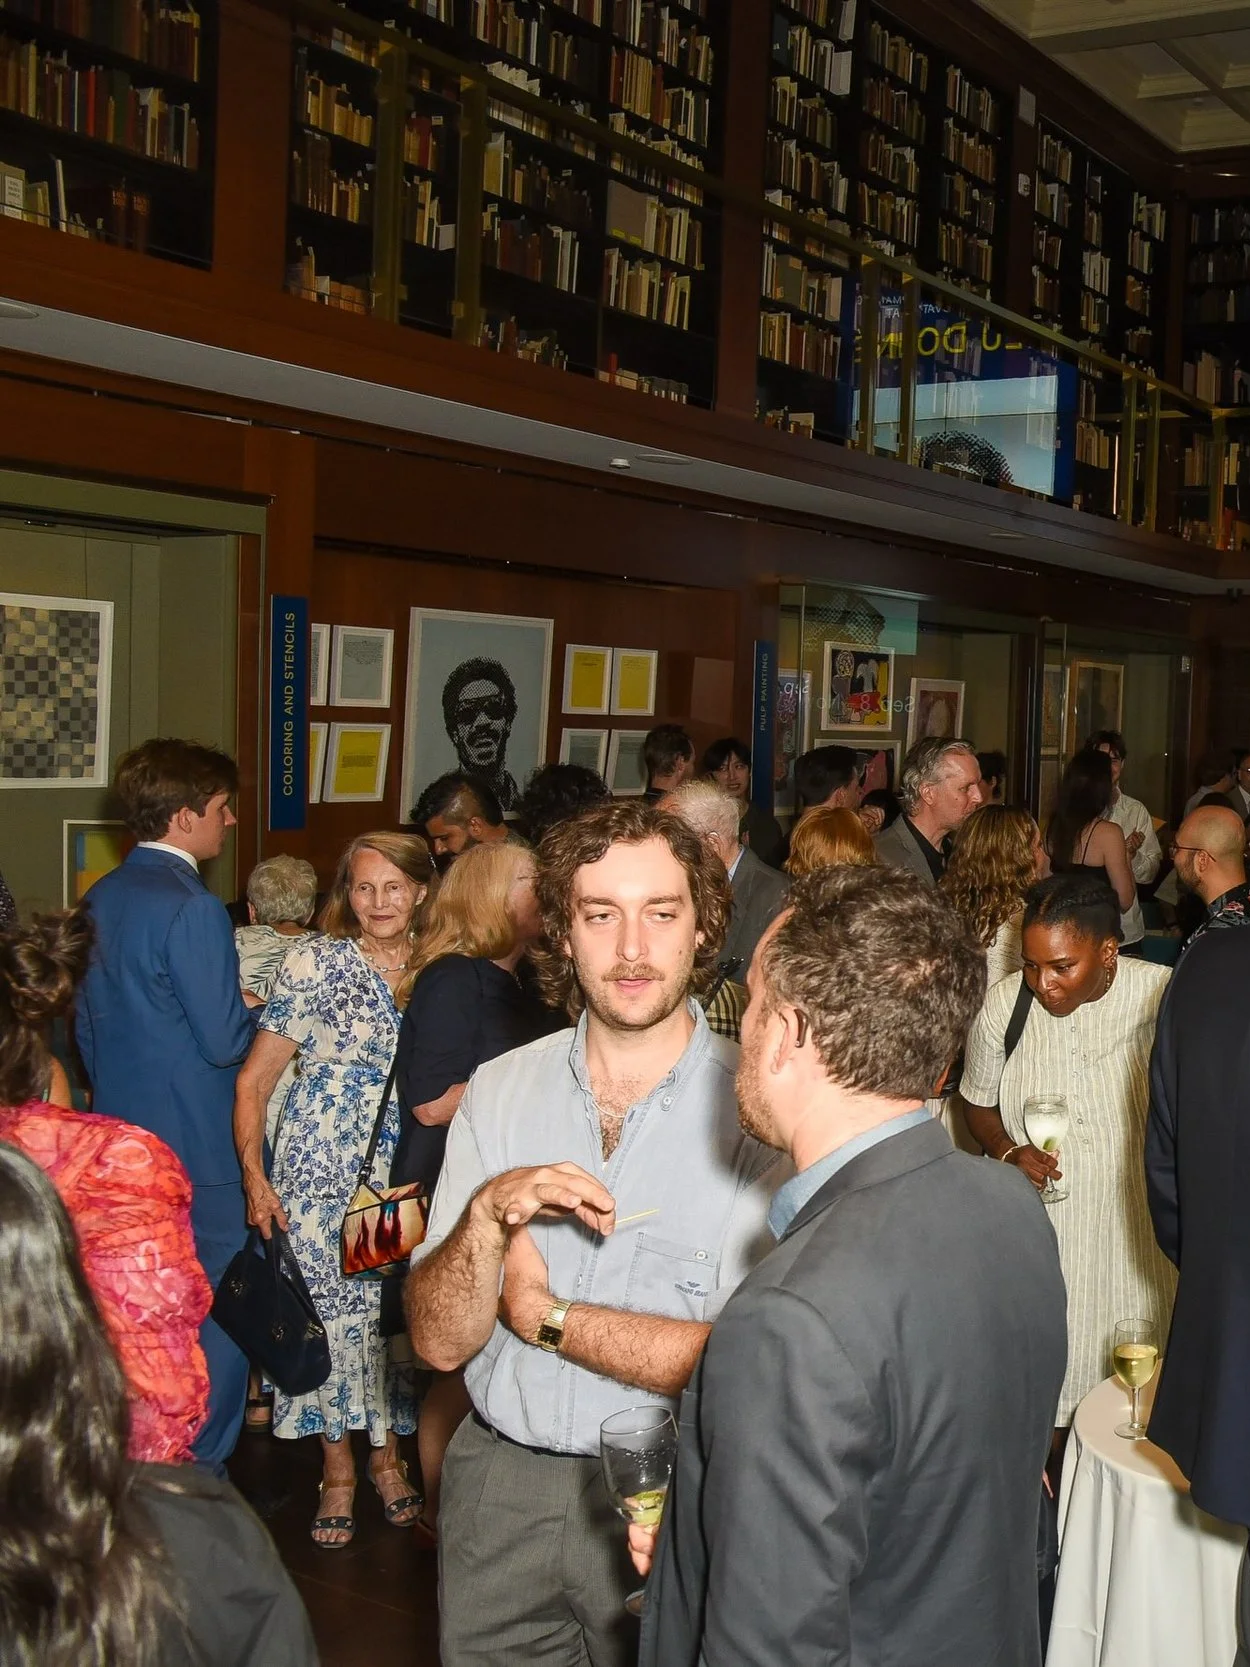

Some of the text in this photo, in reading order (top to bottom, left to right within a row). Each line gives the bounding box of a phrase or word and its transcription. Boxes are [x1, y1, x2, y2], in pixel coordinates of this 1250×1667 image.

[283, 612, 295, 796] COLORING AND STENCILS
[759, 653, 769, 731] PULP PAINTING
